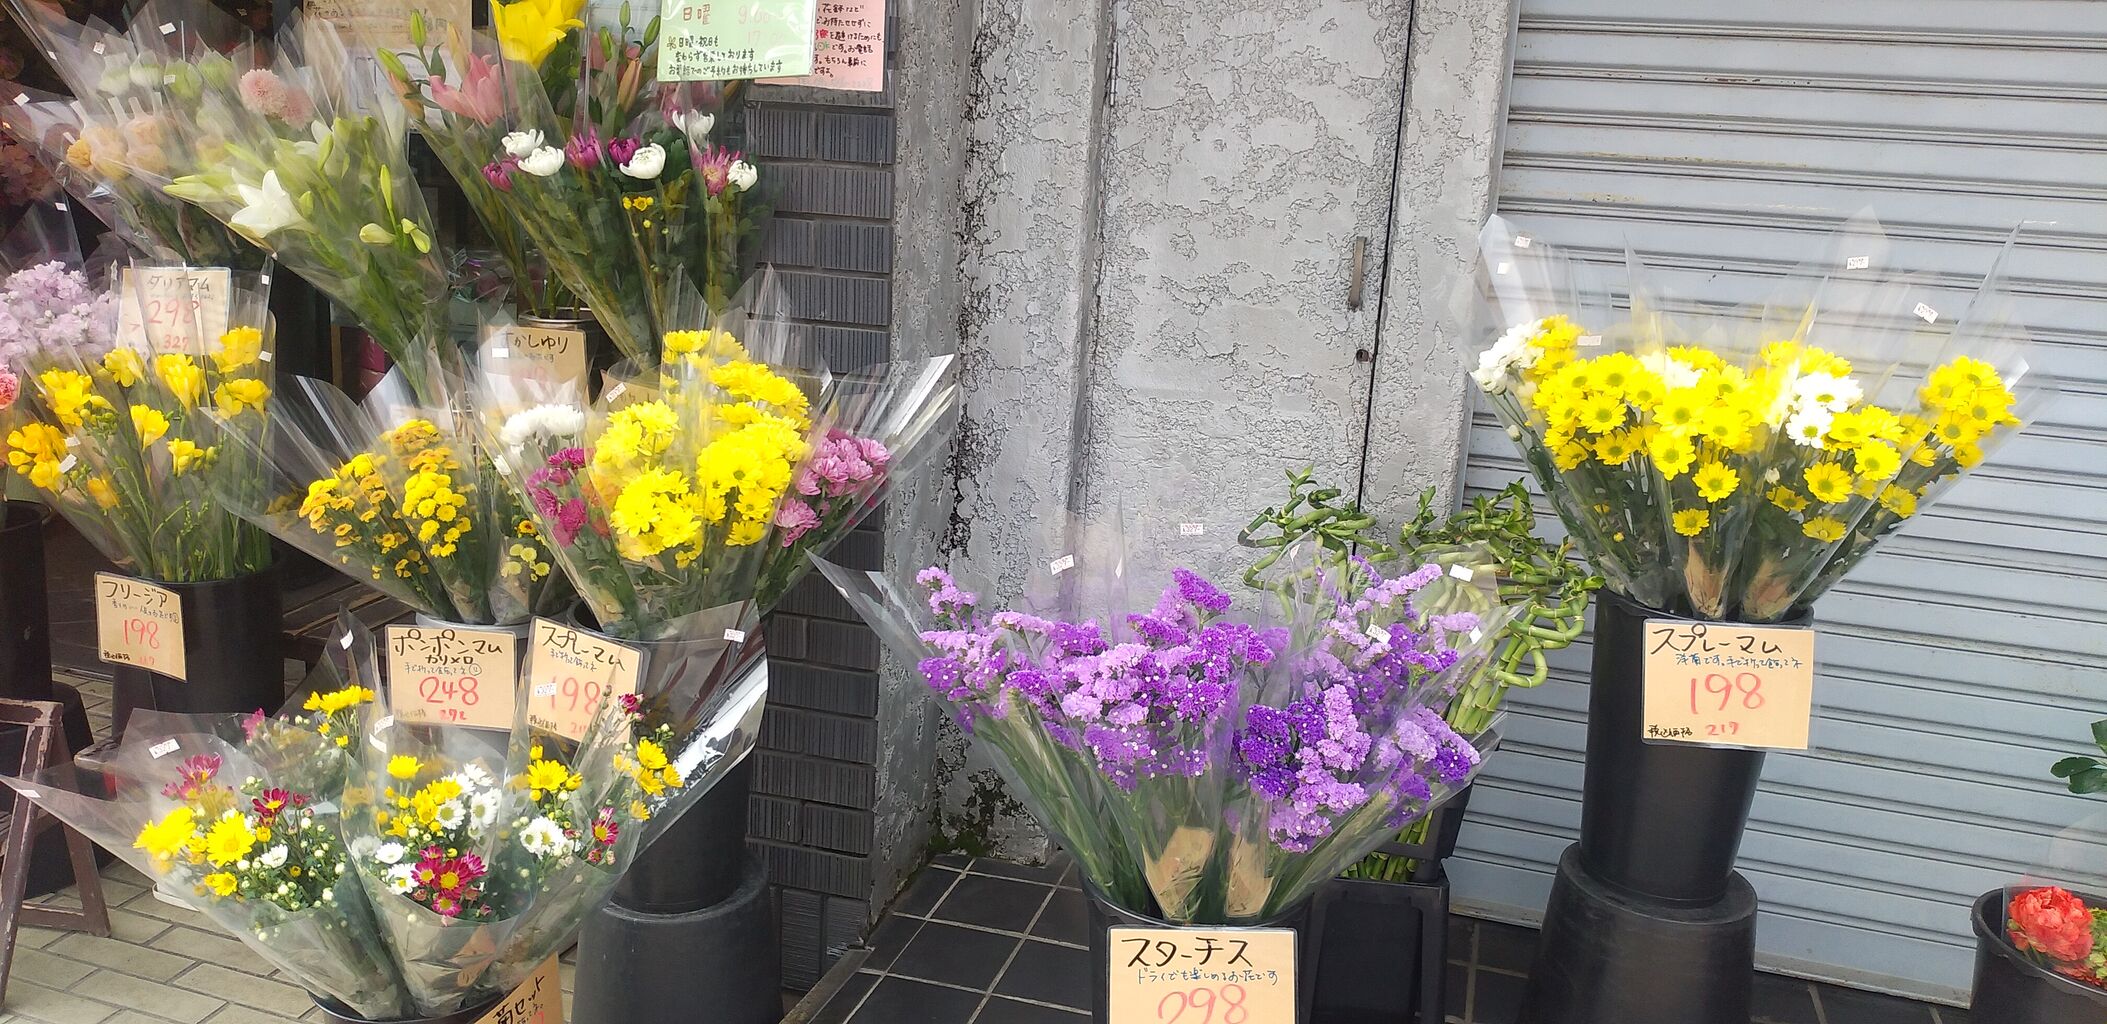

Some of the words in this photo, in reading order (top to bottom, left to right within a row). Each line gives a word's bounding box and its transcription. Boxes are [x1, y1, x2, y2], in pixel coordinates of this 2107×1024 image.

[683, 4, 711, 25] 日曜
[148, 300, 200, 327] 298
[102, 581, 168, 608] フリージア
[124, 619, 160, 650] 198
[392, 629, 503, 656] ポンポンマム
[542, 625, 626, 672] スプレーマム
[1651, 623, 1783, 655] スプレーマム
[425, 654, 474, 665] カリメロ
[419, 676, 479, 705] 248
[551, 676, 601, 715] 198
[1690, 672, 1766, 714] 198
[1647, 724, 1693, 738] 税込価格
[1705, 721, 1739, 736] 217
[1121, 937, 1253, 968] スターチス
[1138, 967, 1279, 985] ドライでも楽しめるお花です
[1157, 983, 1248, 1024] 298
